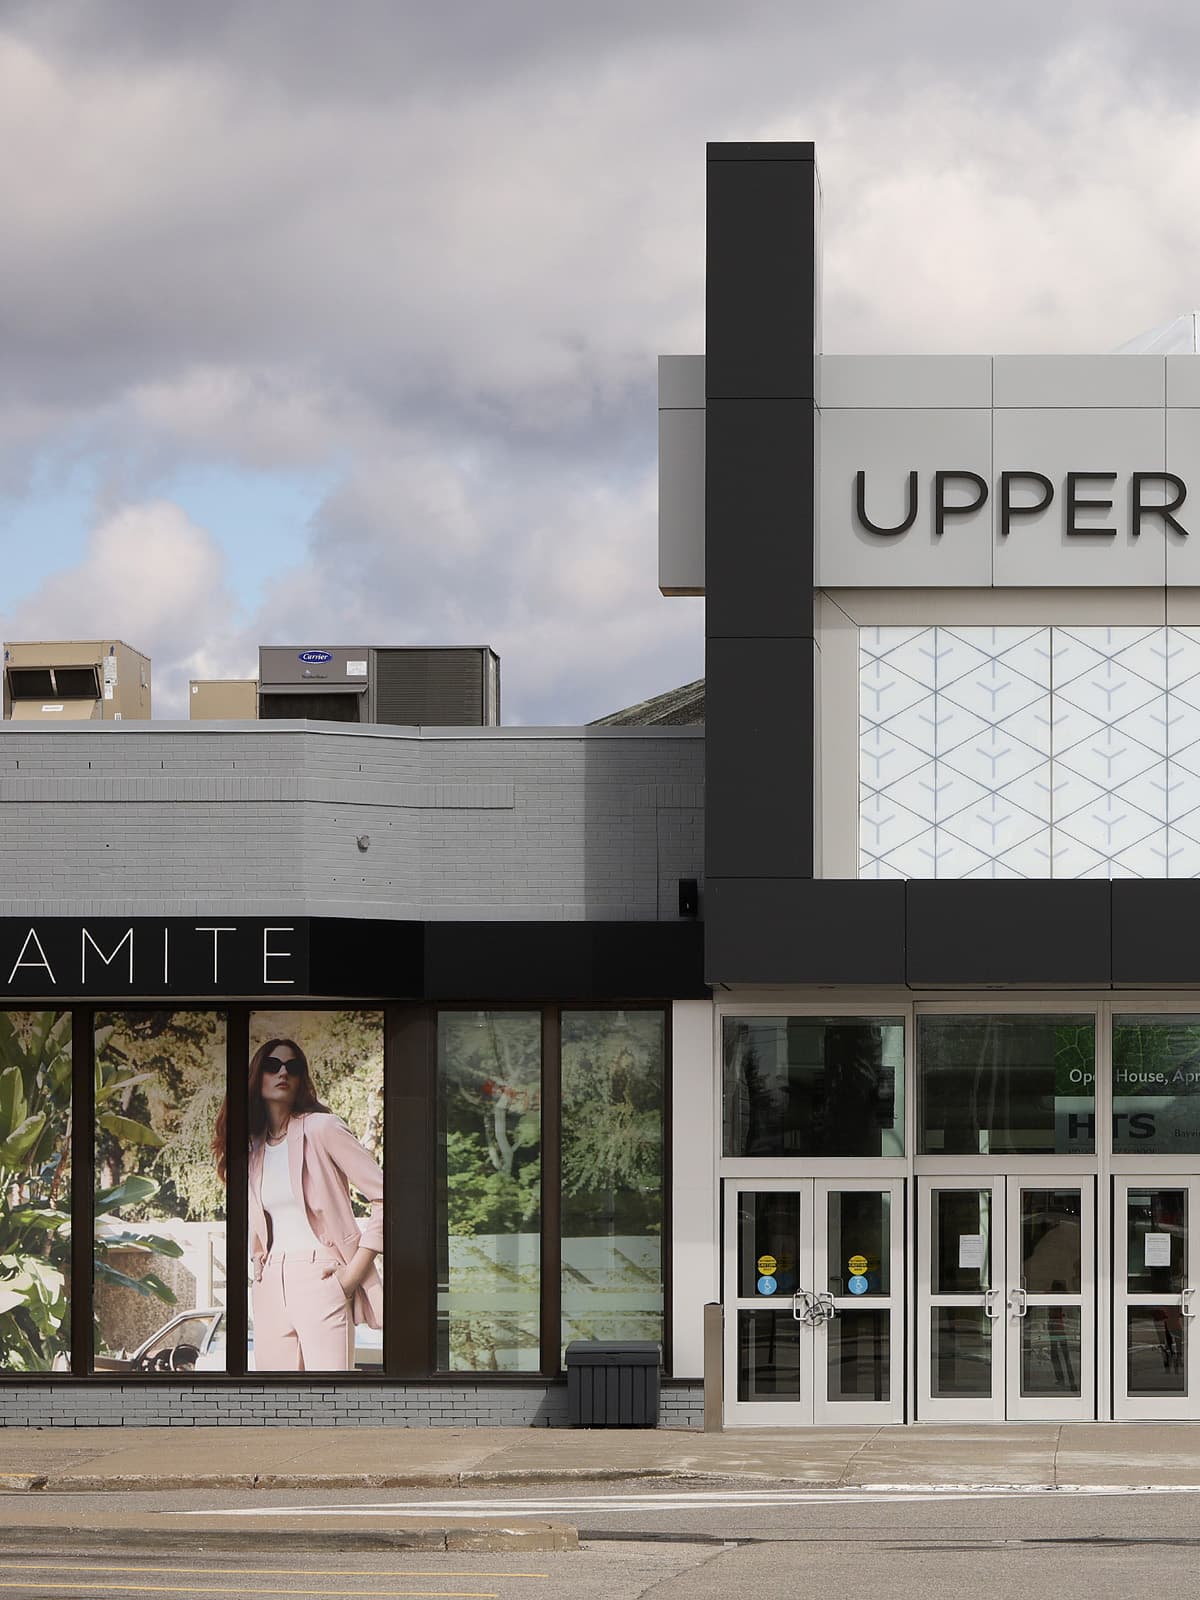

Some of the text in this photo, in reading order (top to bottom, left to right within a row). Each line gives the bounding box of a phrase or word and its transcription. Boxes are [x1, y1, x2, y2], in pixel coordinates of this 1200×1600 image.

[856, 470, 1190, 536] UPPER
[302, 653, 329, 661] Carrier
[7, 927, 295, 984] AMITE
[1116, 1068, 1169, 1085] House,
[1068, 1113, 1156, 1139] HTS
